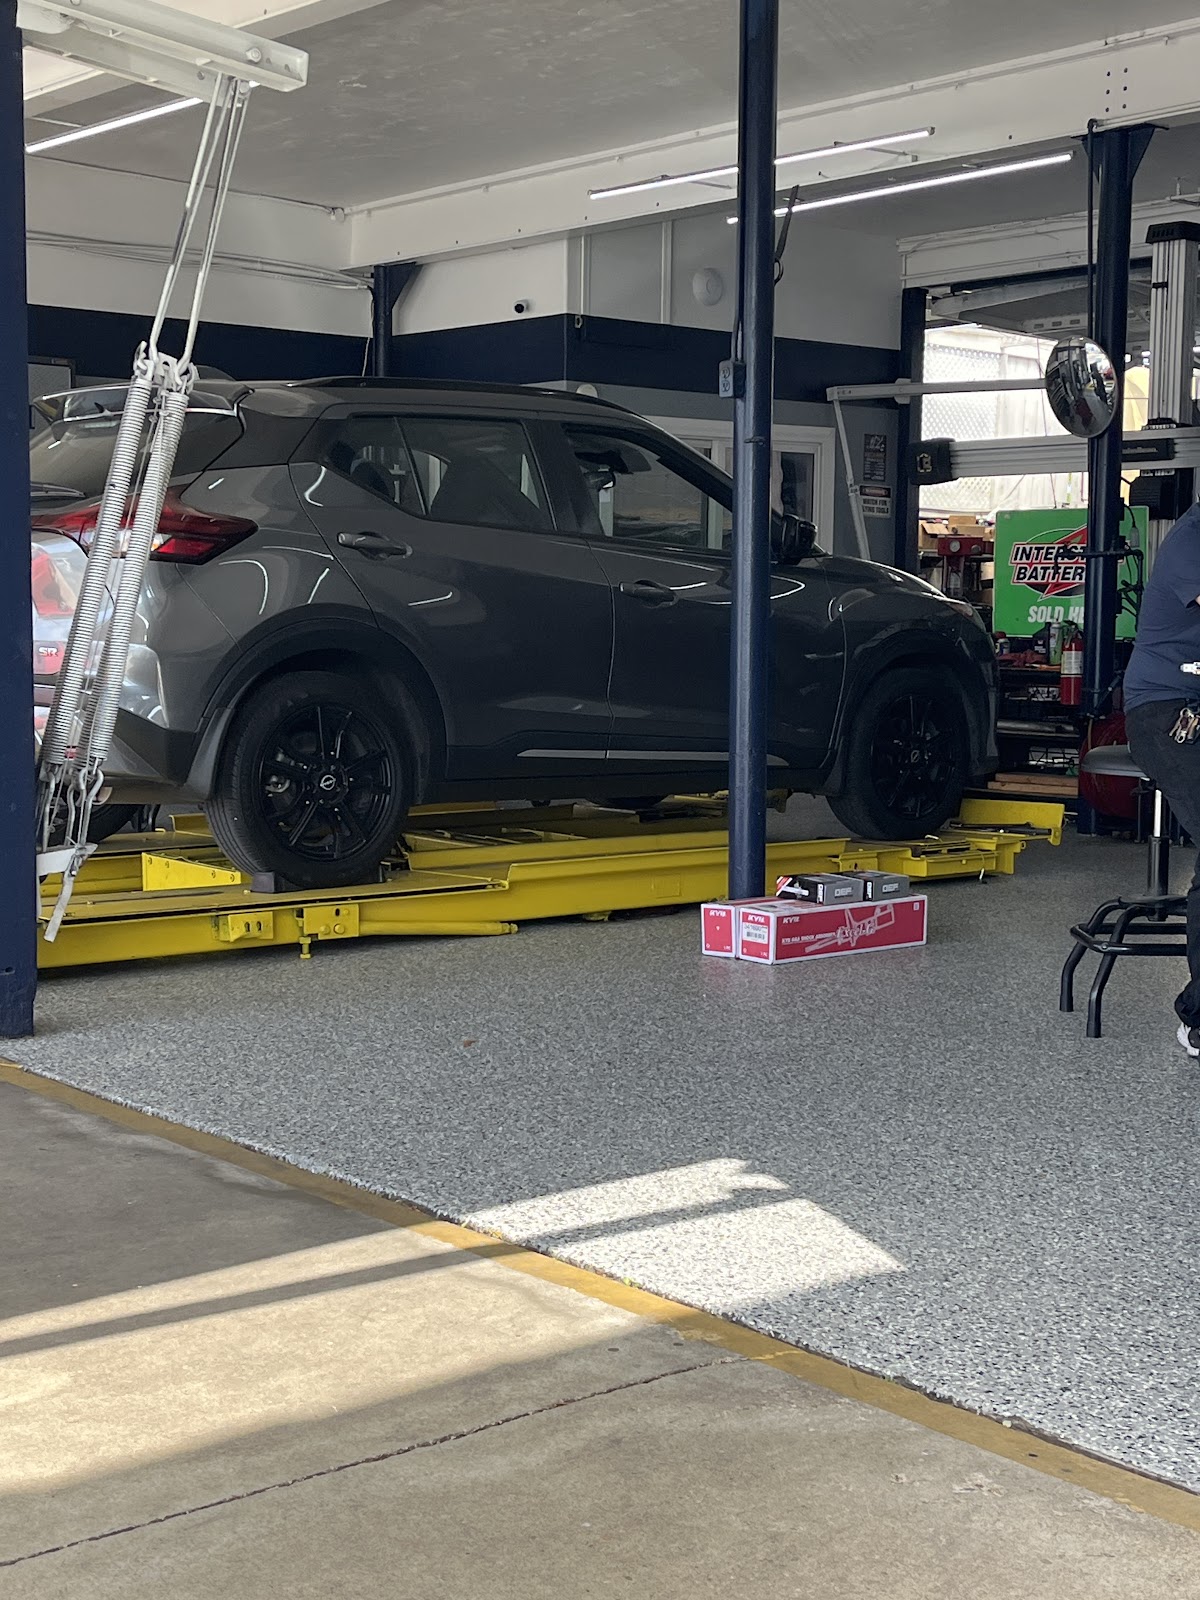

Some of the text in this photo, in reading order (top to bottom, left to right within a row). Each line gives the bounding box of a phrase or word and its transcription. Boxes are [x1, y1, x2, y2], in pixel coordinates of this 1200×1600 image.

[1016, 565, 1086, 581] BATTER
[1028, 605, 1065, 623] SOLD
[38, 646, 59, 657] SR
